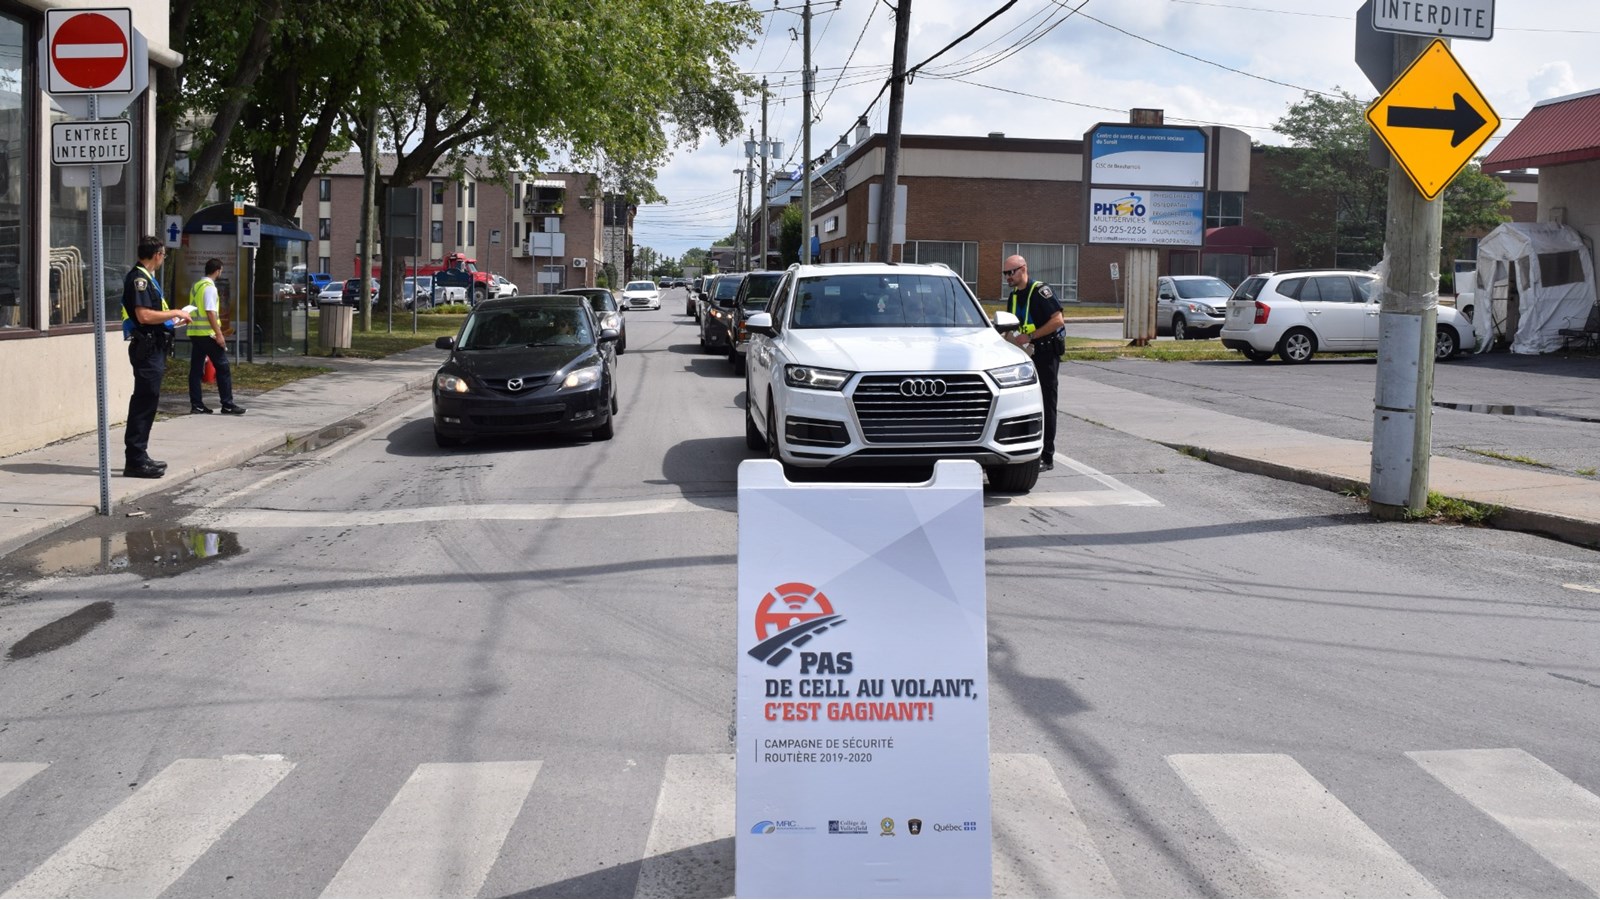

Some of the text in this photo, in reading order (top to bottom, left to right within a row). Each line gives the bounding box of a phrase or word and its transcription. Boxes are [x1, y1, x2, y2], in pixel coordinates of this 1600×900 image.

[1382, 0, 1485, 28] INTERDITE
[65, 126, 118, 141] ENTRÉE
[57, 145, 126, 158] INTERDITE
[1094, 201, 1146, 217] PHYSIO
[1092, 225, 1147, 235] 450 225-2256
[800, 652, 854, 675] PAS
[765, 679, 978, 700] DE CELL AU VOLANT,
[764, 702, 934, 721] C'EST GAGNANT!
[764, 736, 894, 748] CAMPAGNE DE SÉCURITÉ
[764, 751, 873, 763] ROUTIÈRE 2019-2020
[933, 822, 962, 832] Québec
